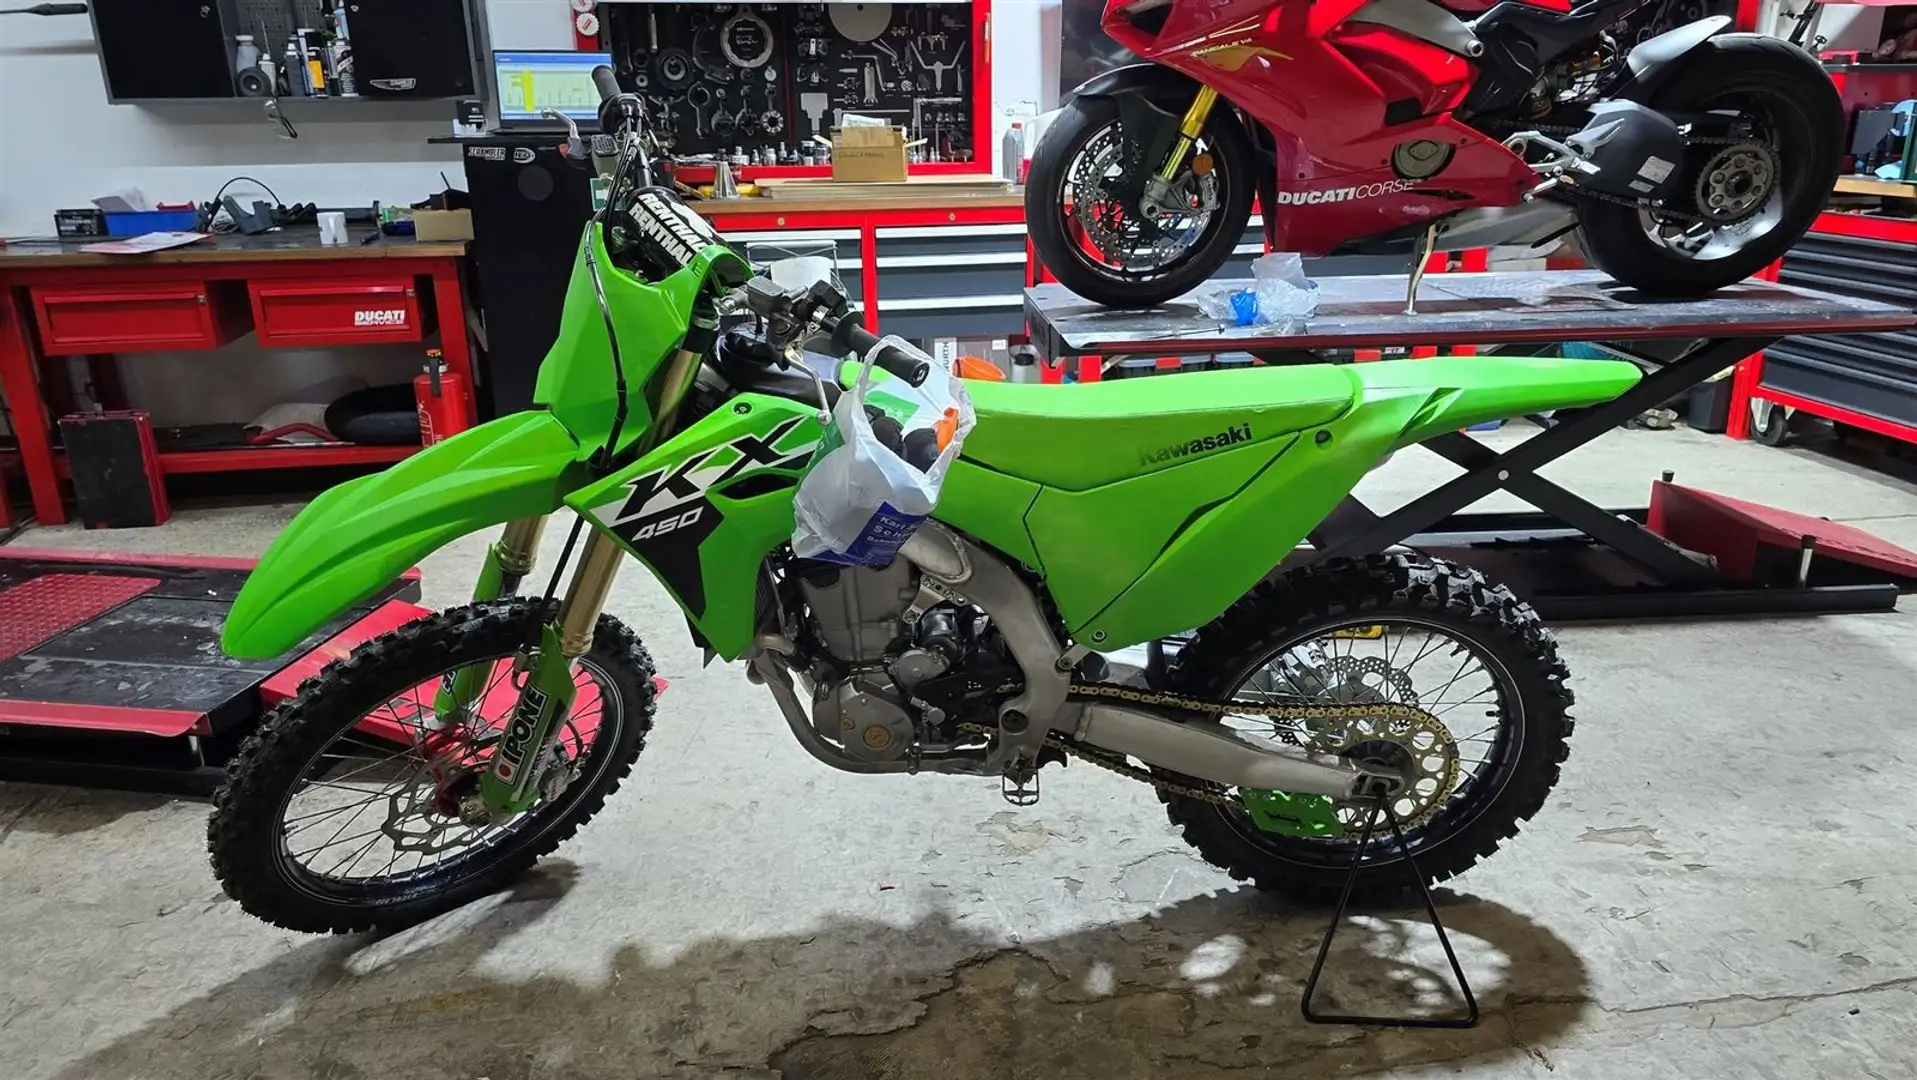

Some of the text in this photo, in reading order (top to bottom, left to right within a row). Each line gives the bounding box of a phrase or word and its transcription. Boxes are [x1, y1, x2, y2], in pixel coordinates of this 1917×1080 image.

[628, 202, 694, 267] RENTHAL
[637, 193, 709, 253] RENTHAL
[354, 310, 405, 321] DUCATI
[614, 415, 804, 521] KX
[1140, 422, 1252, 466] Kawasaki
[631, 506, 704, 542] 450
[501, 684, 547, 765] IPONE
